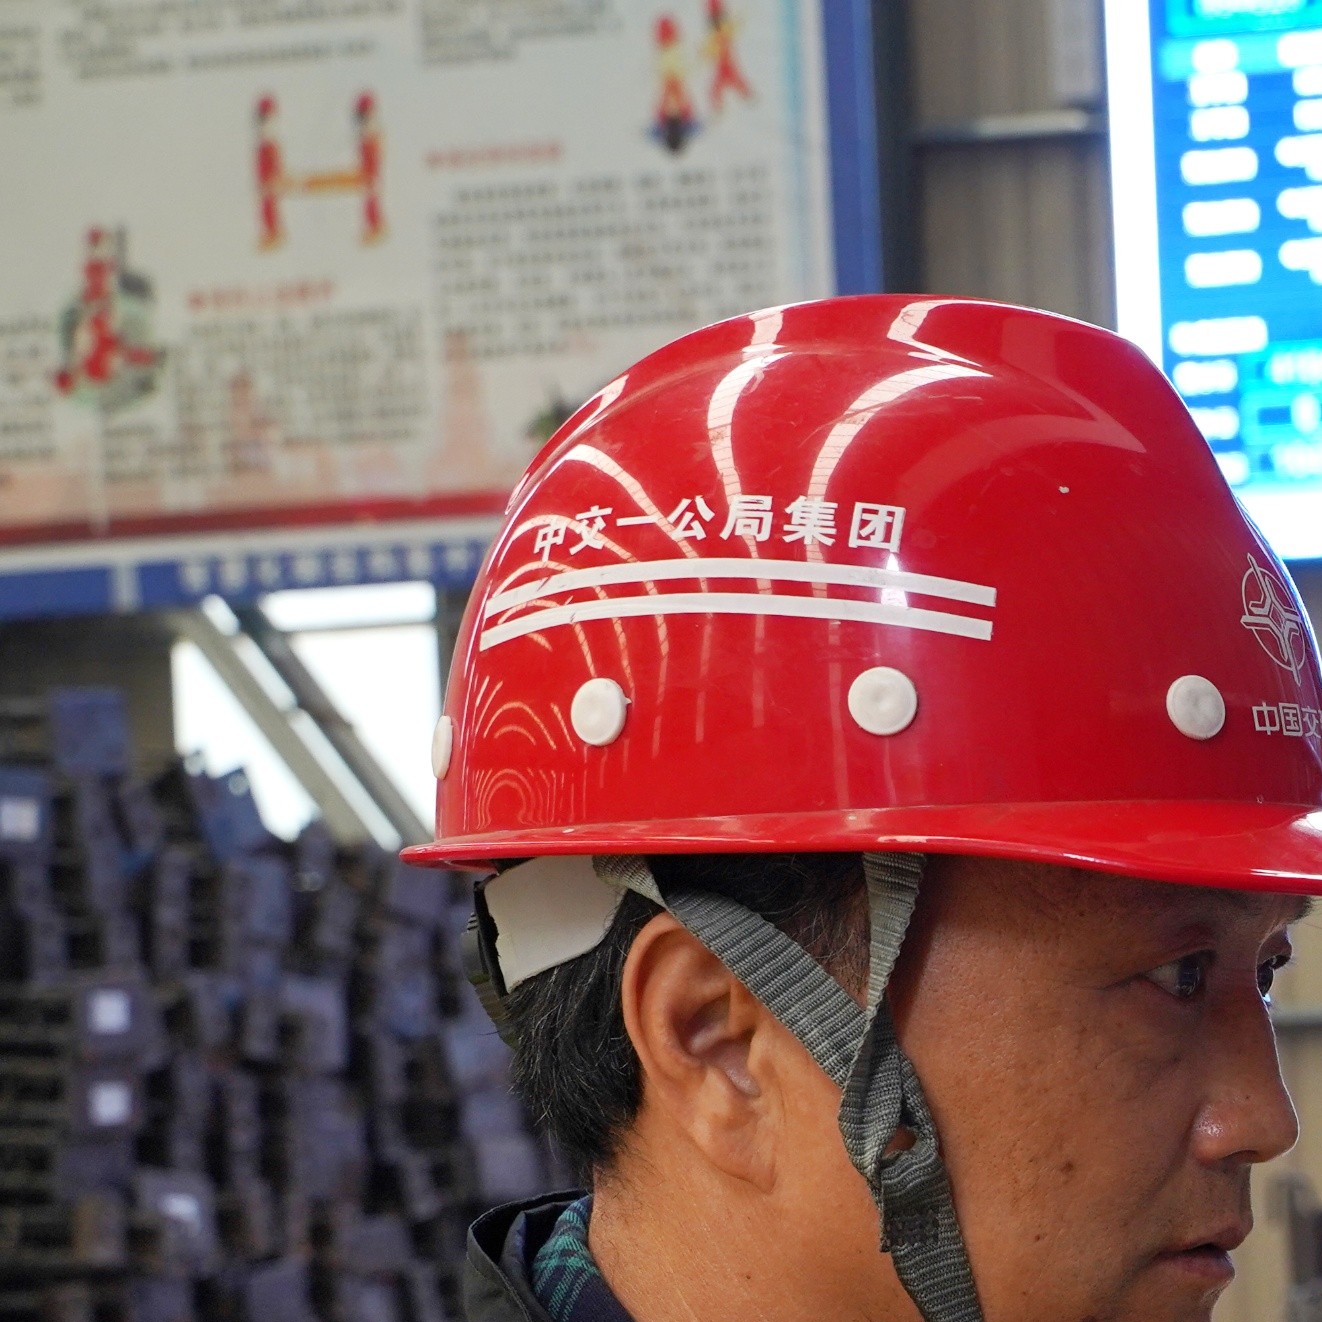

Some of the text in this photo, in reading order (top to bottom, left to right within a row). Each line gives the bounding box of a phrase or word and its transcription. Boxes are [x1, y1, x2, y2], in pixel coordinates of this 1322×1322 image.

[533, 494, 906, 563] 中交一公局集团
